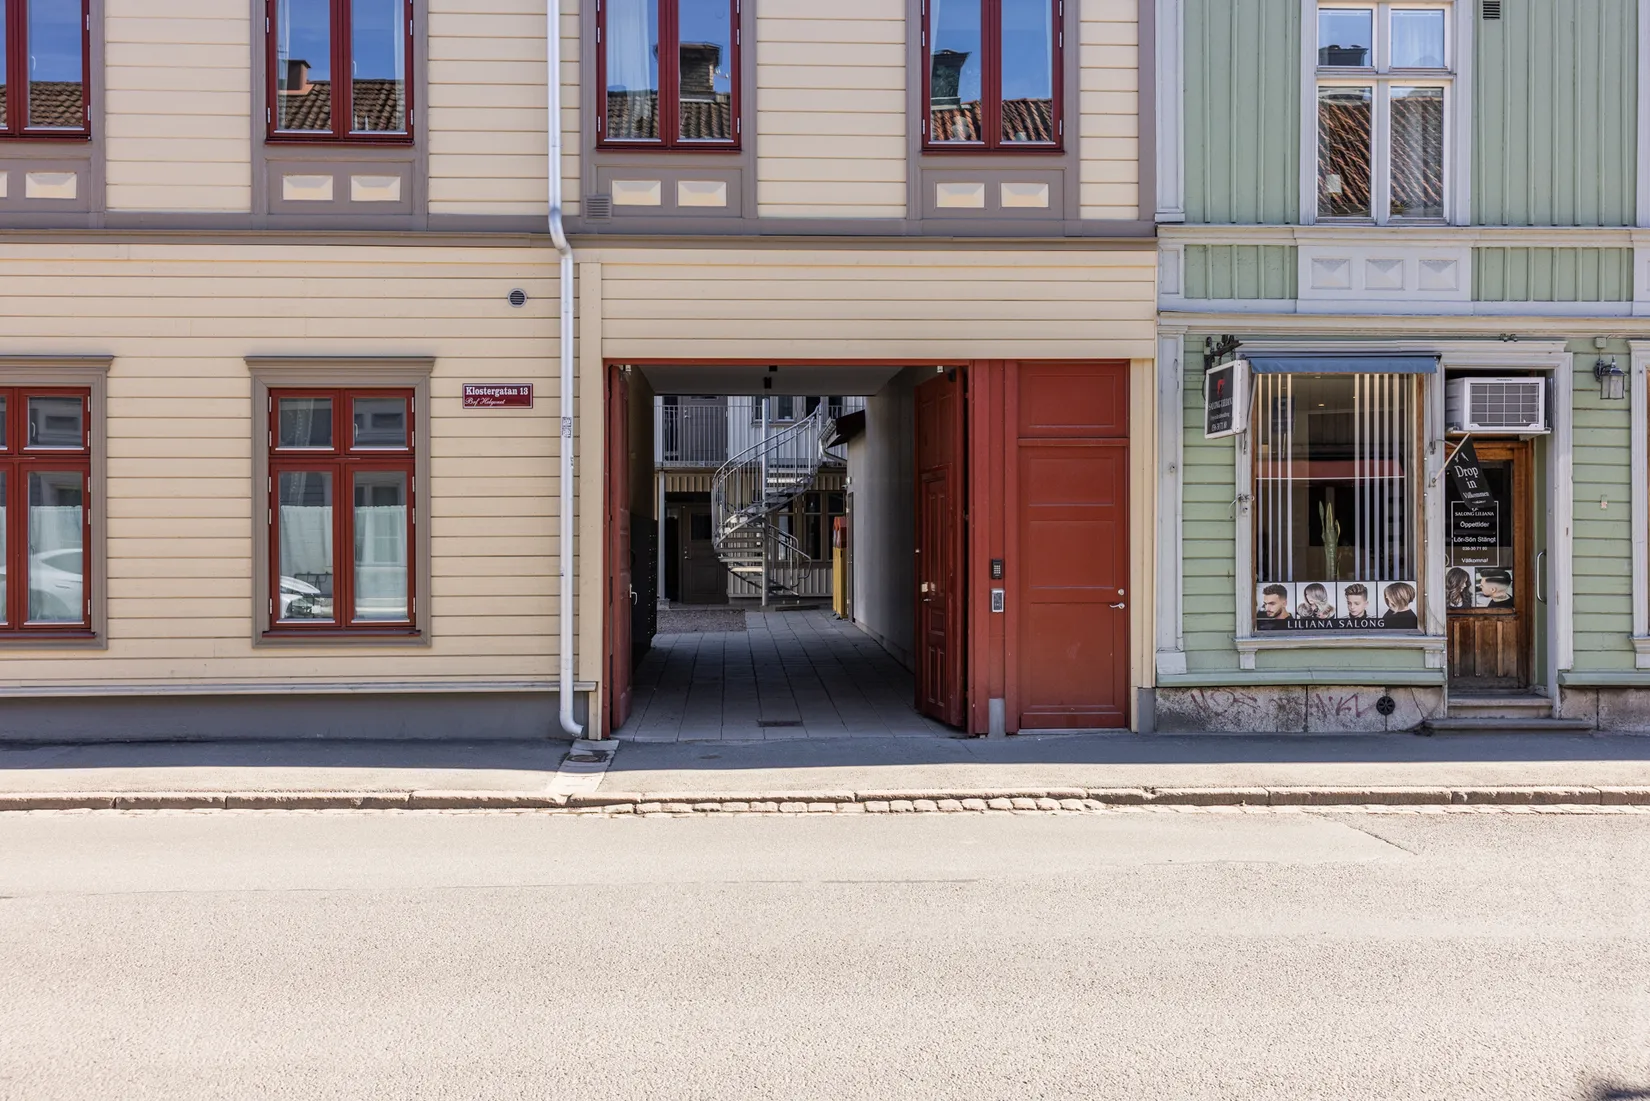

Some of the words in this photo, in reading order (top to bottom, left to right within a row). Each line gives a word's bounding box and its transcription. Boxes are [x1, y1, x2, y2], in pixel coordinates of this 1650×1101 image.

[466, 386, 518, 397] Klostergatan
[519, 387, 529, 395] 13
[1454, 465, 1479, 478] Drop
[1466, 477, 1478, 489] in
[1460, 520, 1490, 528] Öppettider
[1287, 620, 1333, 629] LILIANA
[1339, 619, 1385, 628] SALONG
